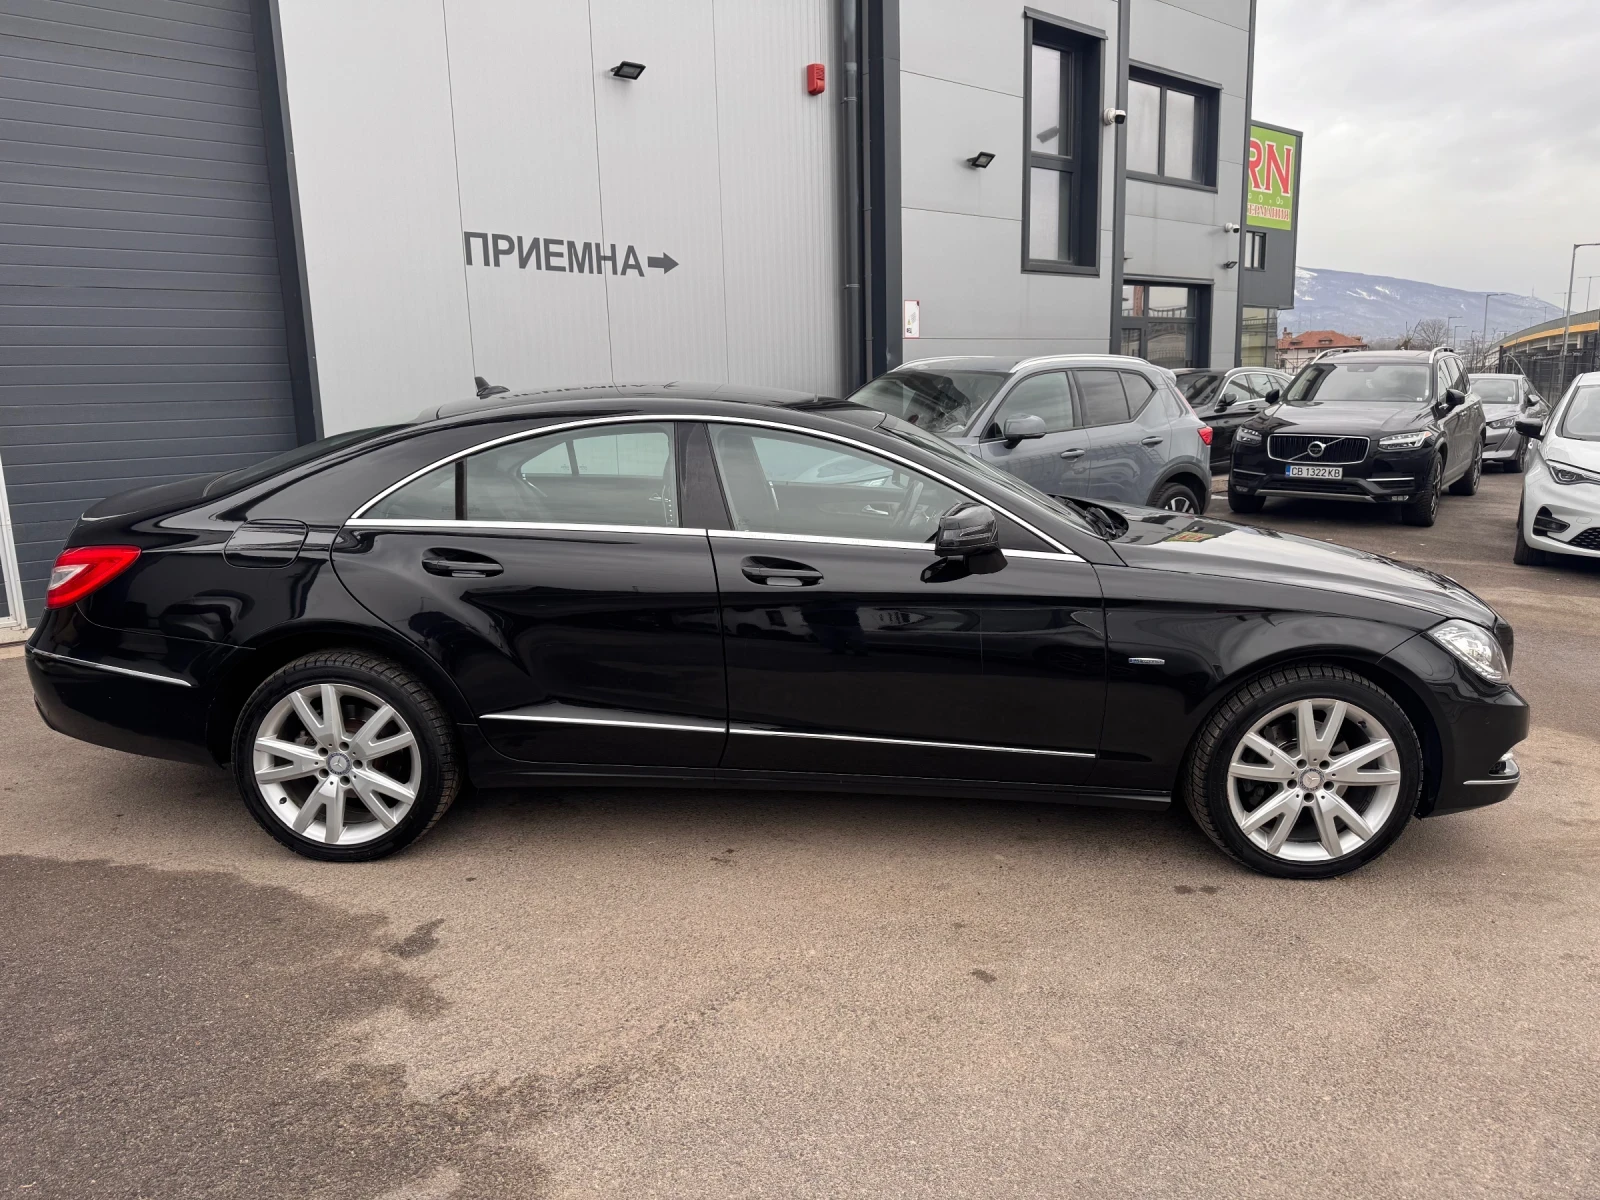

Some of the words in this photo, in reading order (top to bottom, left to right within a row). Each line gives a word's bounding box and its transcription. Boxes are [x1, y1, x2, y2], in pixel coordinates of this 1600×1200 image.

[1247, 203, 1290, 221] ЕРМАНИЯ
[464, 231, 645, 277] ПРИЕМНА
[1291, 467, 1303, 476] CB
[1306, 467, 1327, 477] 1322
[1328, 468, 1340, 478] KB
